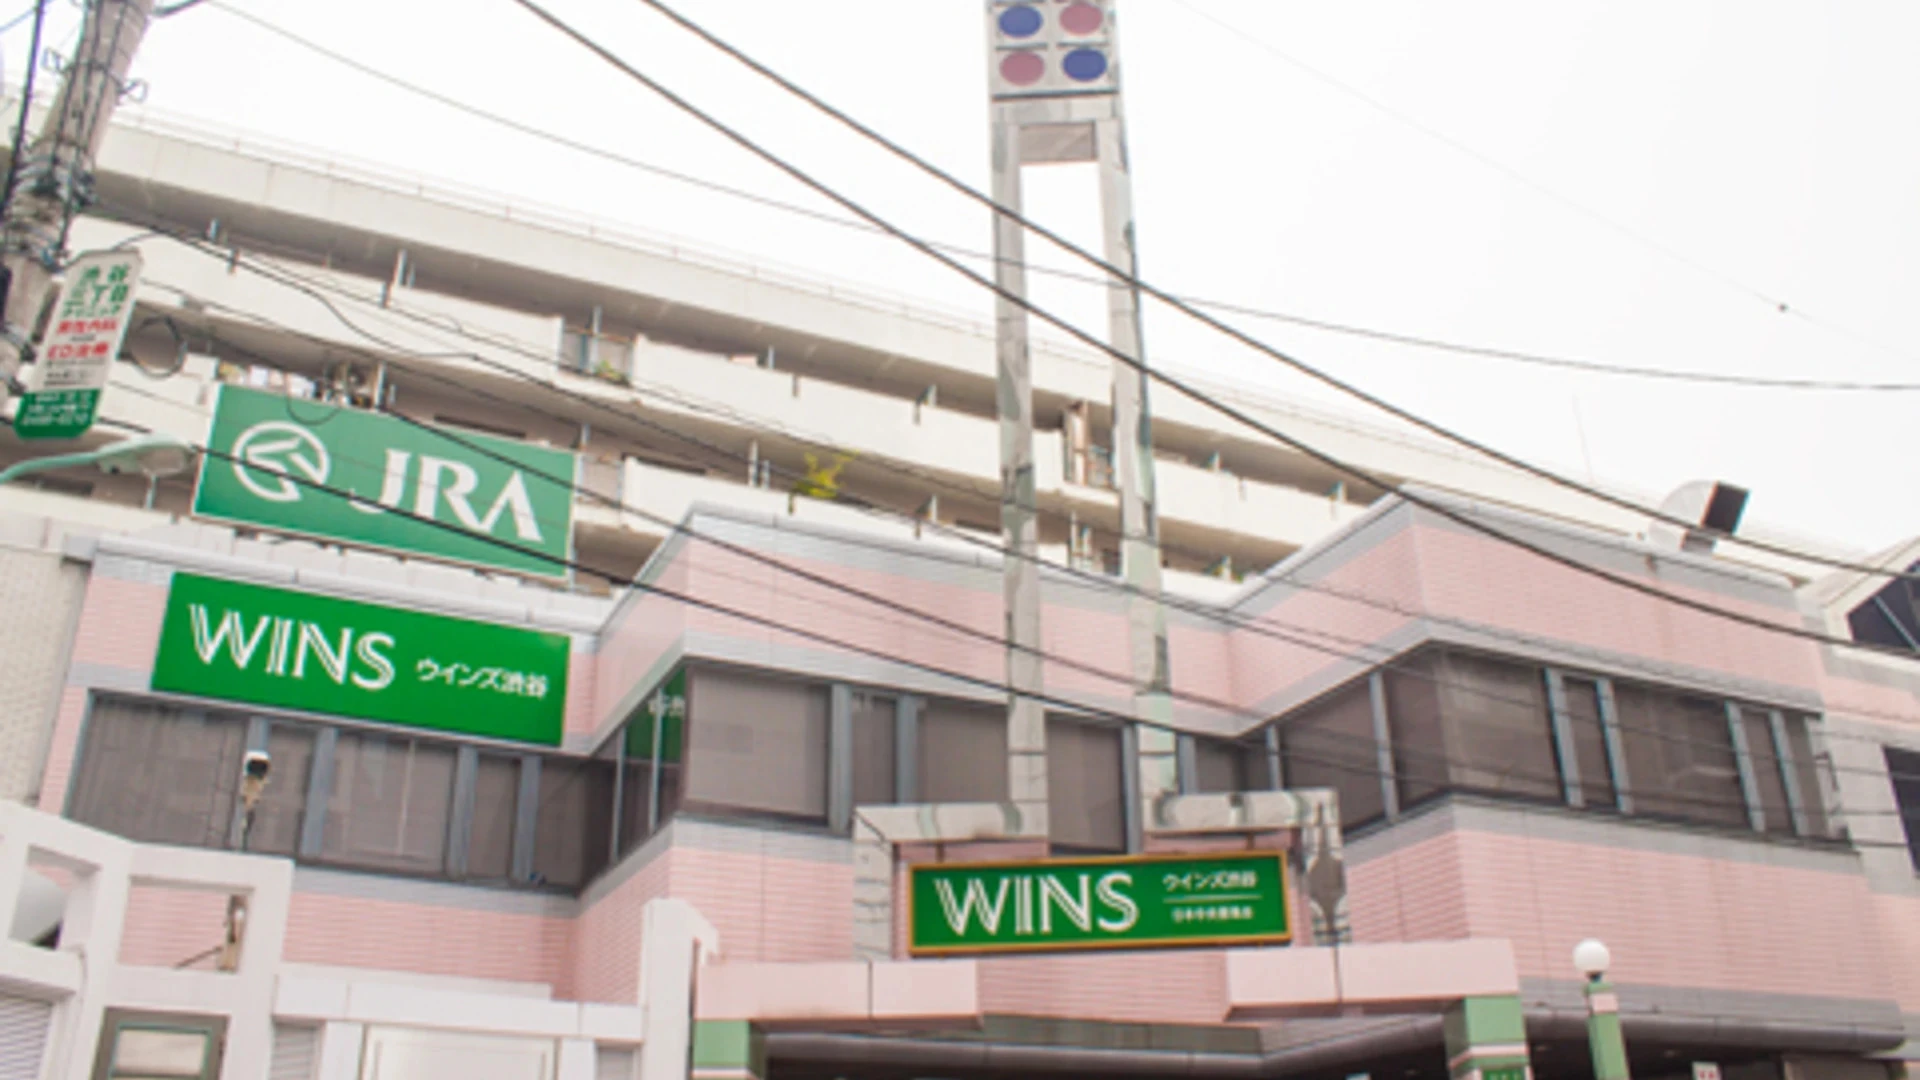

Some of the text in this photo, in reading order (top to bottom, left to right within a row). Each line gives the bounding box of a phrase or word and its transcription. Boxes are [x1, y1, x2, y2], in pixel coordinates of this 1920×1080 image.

[348, 448, 546, 544] JRA
[188, 603, 396, 691] WINS
[415, 656, 548, 700] ウインズ渋谷
[933, 870, 1141, 937] WINS
